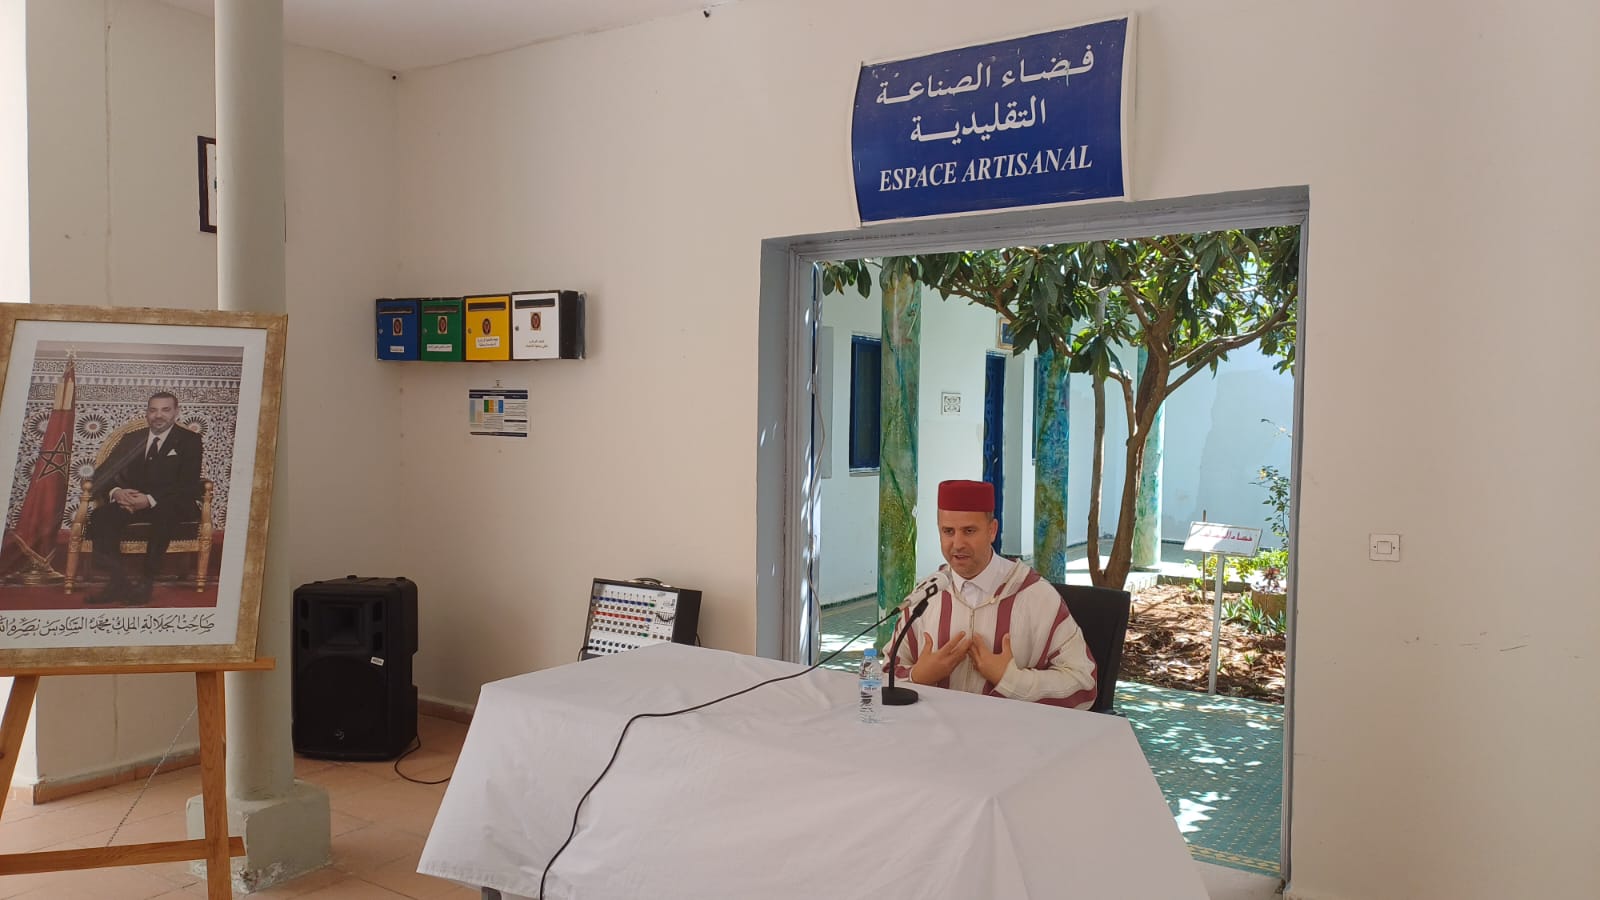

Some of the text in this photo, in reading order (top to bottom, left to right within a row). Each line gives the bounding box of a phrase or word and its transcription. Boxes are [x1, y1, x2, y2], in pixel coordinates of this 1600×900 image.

[876, 44, 1095, 104] فضاء الصناعة
[910, 95, 1046, 144] التقليدية
[879, 145, 1093, 192] ESPACE ARTISANAL
